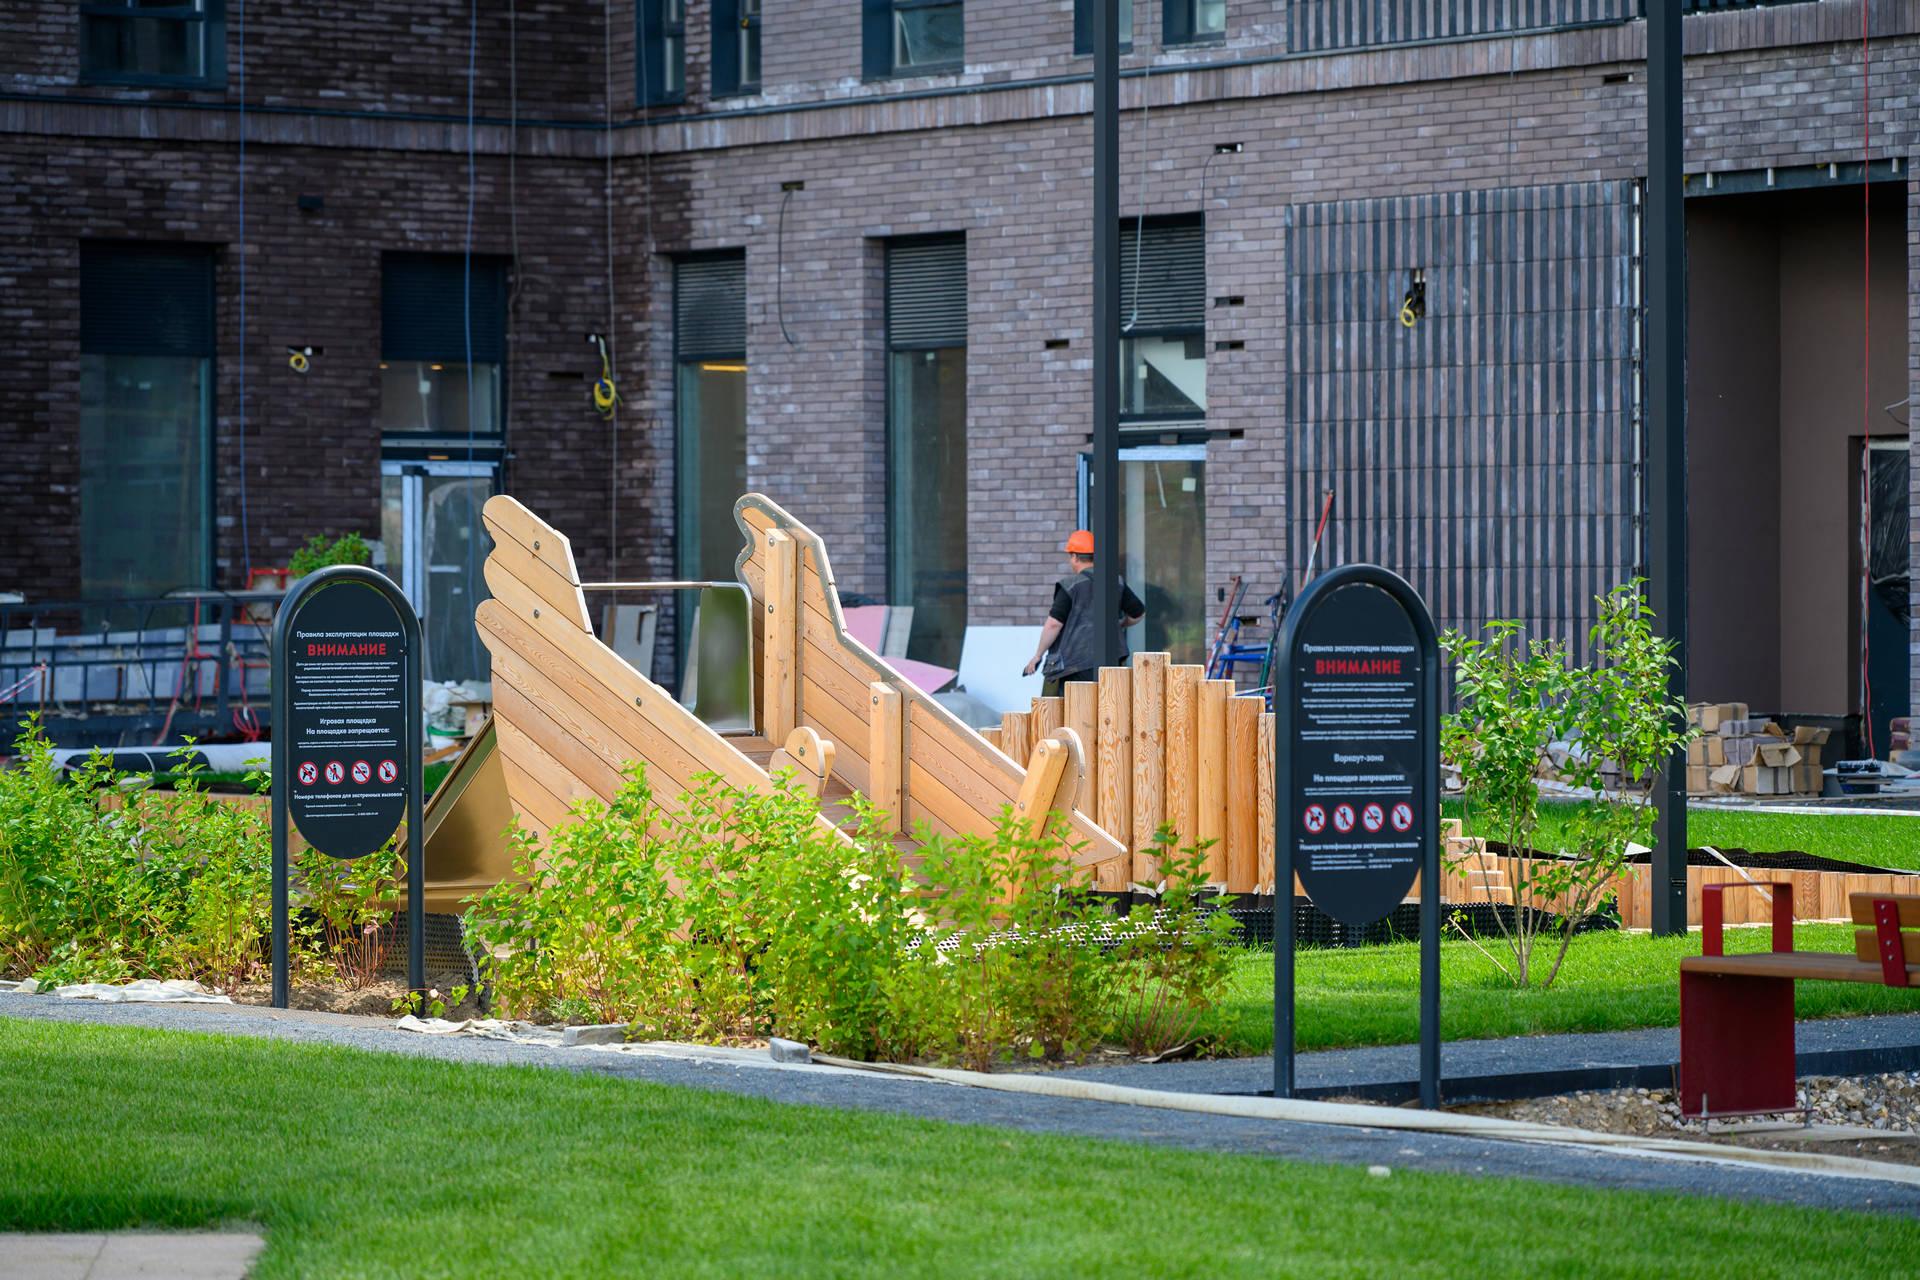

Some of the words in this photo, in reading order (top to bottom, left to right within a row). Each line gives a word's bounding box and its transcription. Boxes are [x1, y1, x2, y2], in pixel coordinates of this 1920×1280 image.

[296, 631, 324, 639] Правила
[307, 644, 386, 656] ВНИМАНИЕ
[1303, 644, 1333, 654] Правила
[1334, 646, 1380, 654] эксплуатации
[1315, 660, 1401, 674] ВНИМАНИЕ
